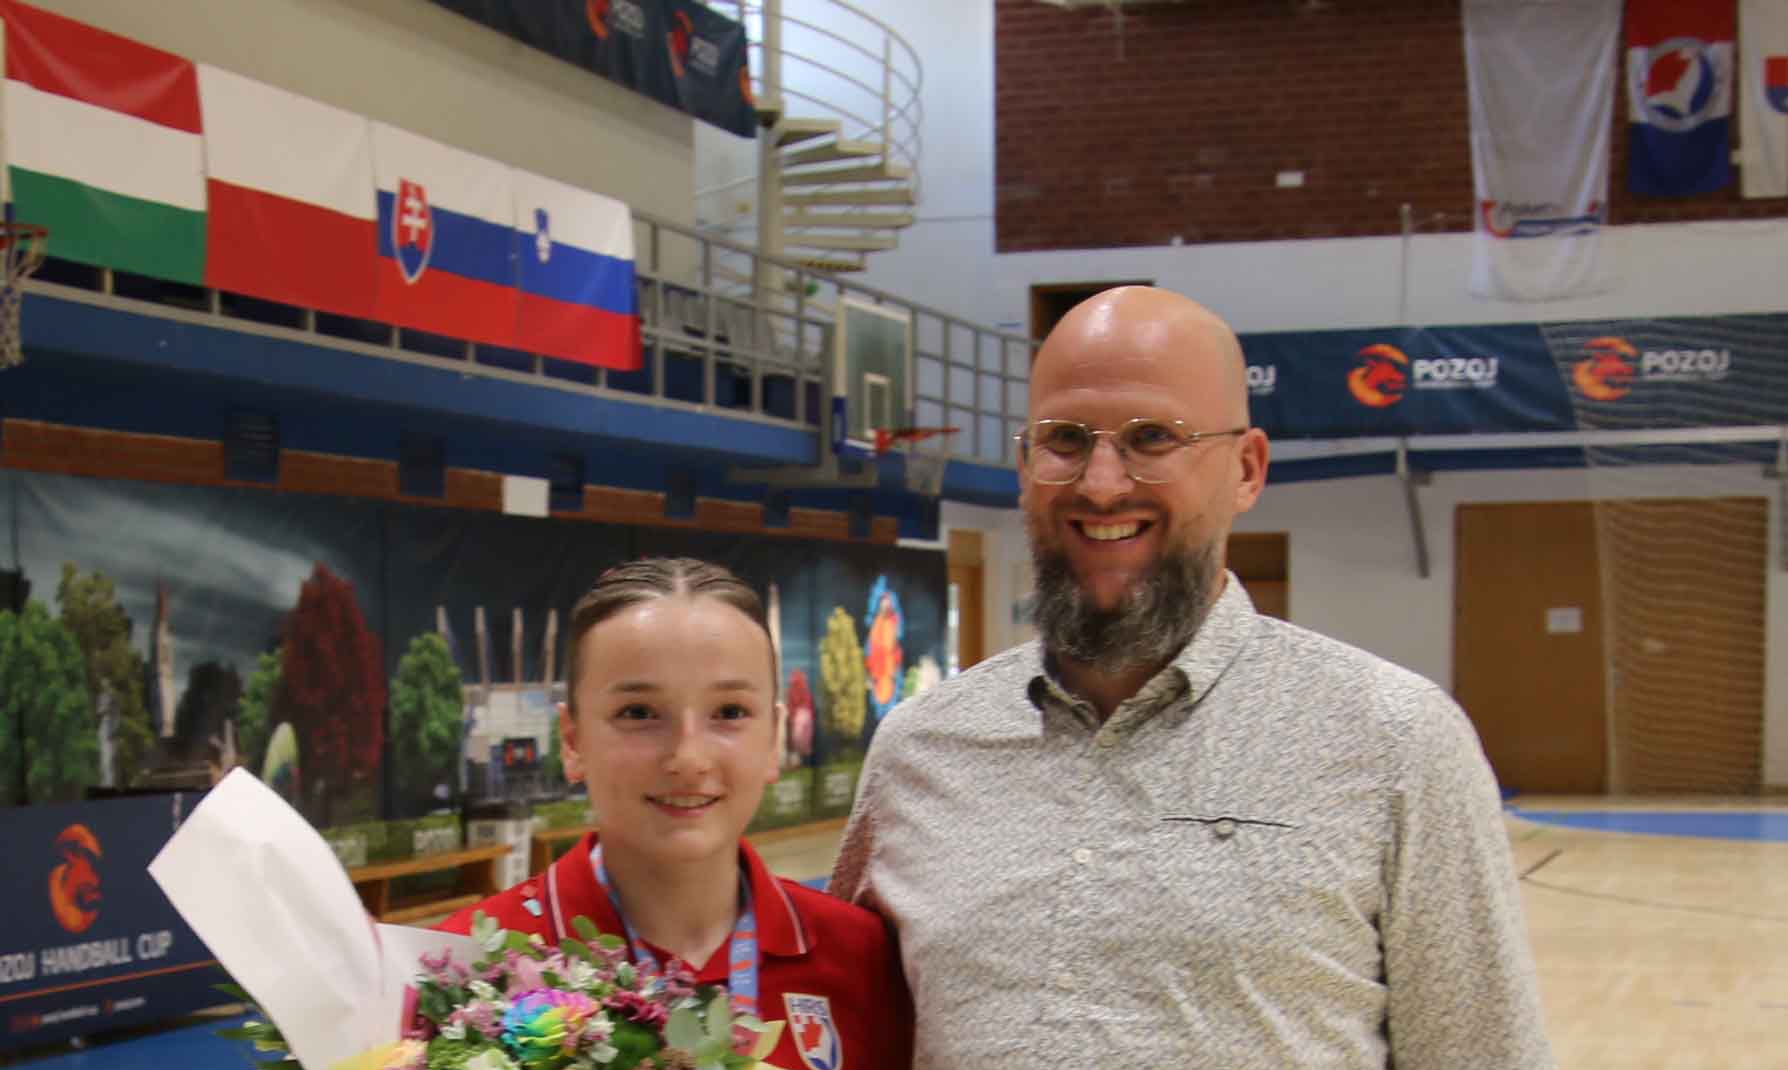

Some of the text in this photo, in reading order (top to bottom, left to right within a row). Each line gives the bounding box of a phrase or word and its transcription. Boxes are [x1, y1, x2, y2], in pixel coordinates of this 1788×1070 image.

[1412, 358, 1498, 381] POZOJ
[1643, 349, 1731, 373] POZOJ
[0, 930, 173, 983] ZOJ HANDBALL CUP
